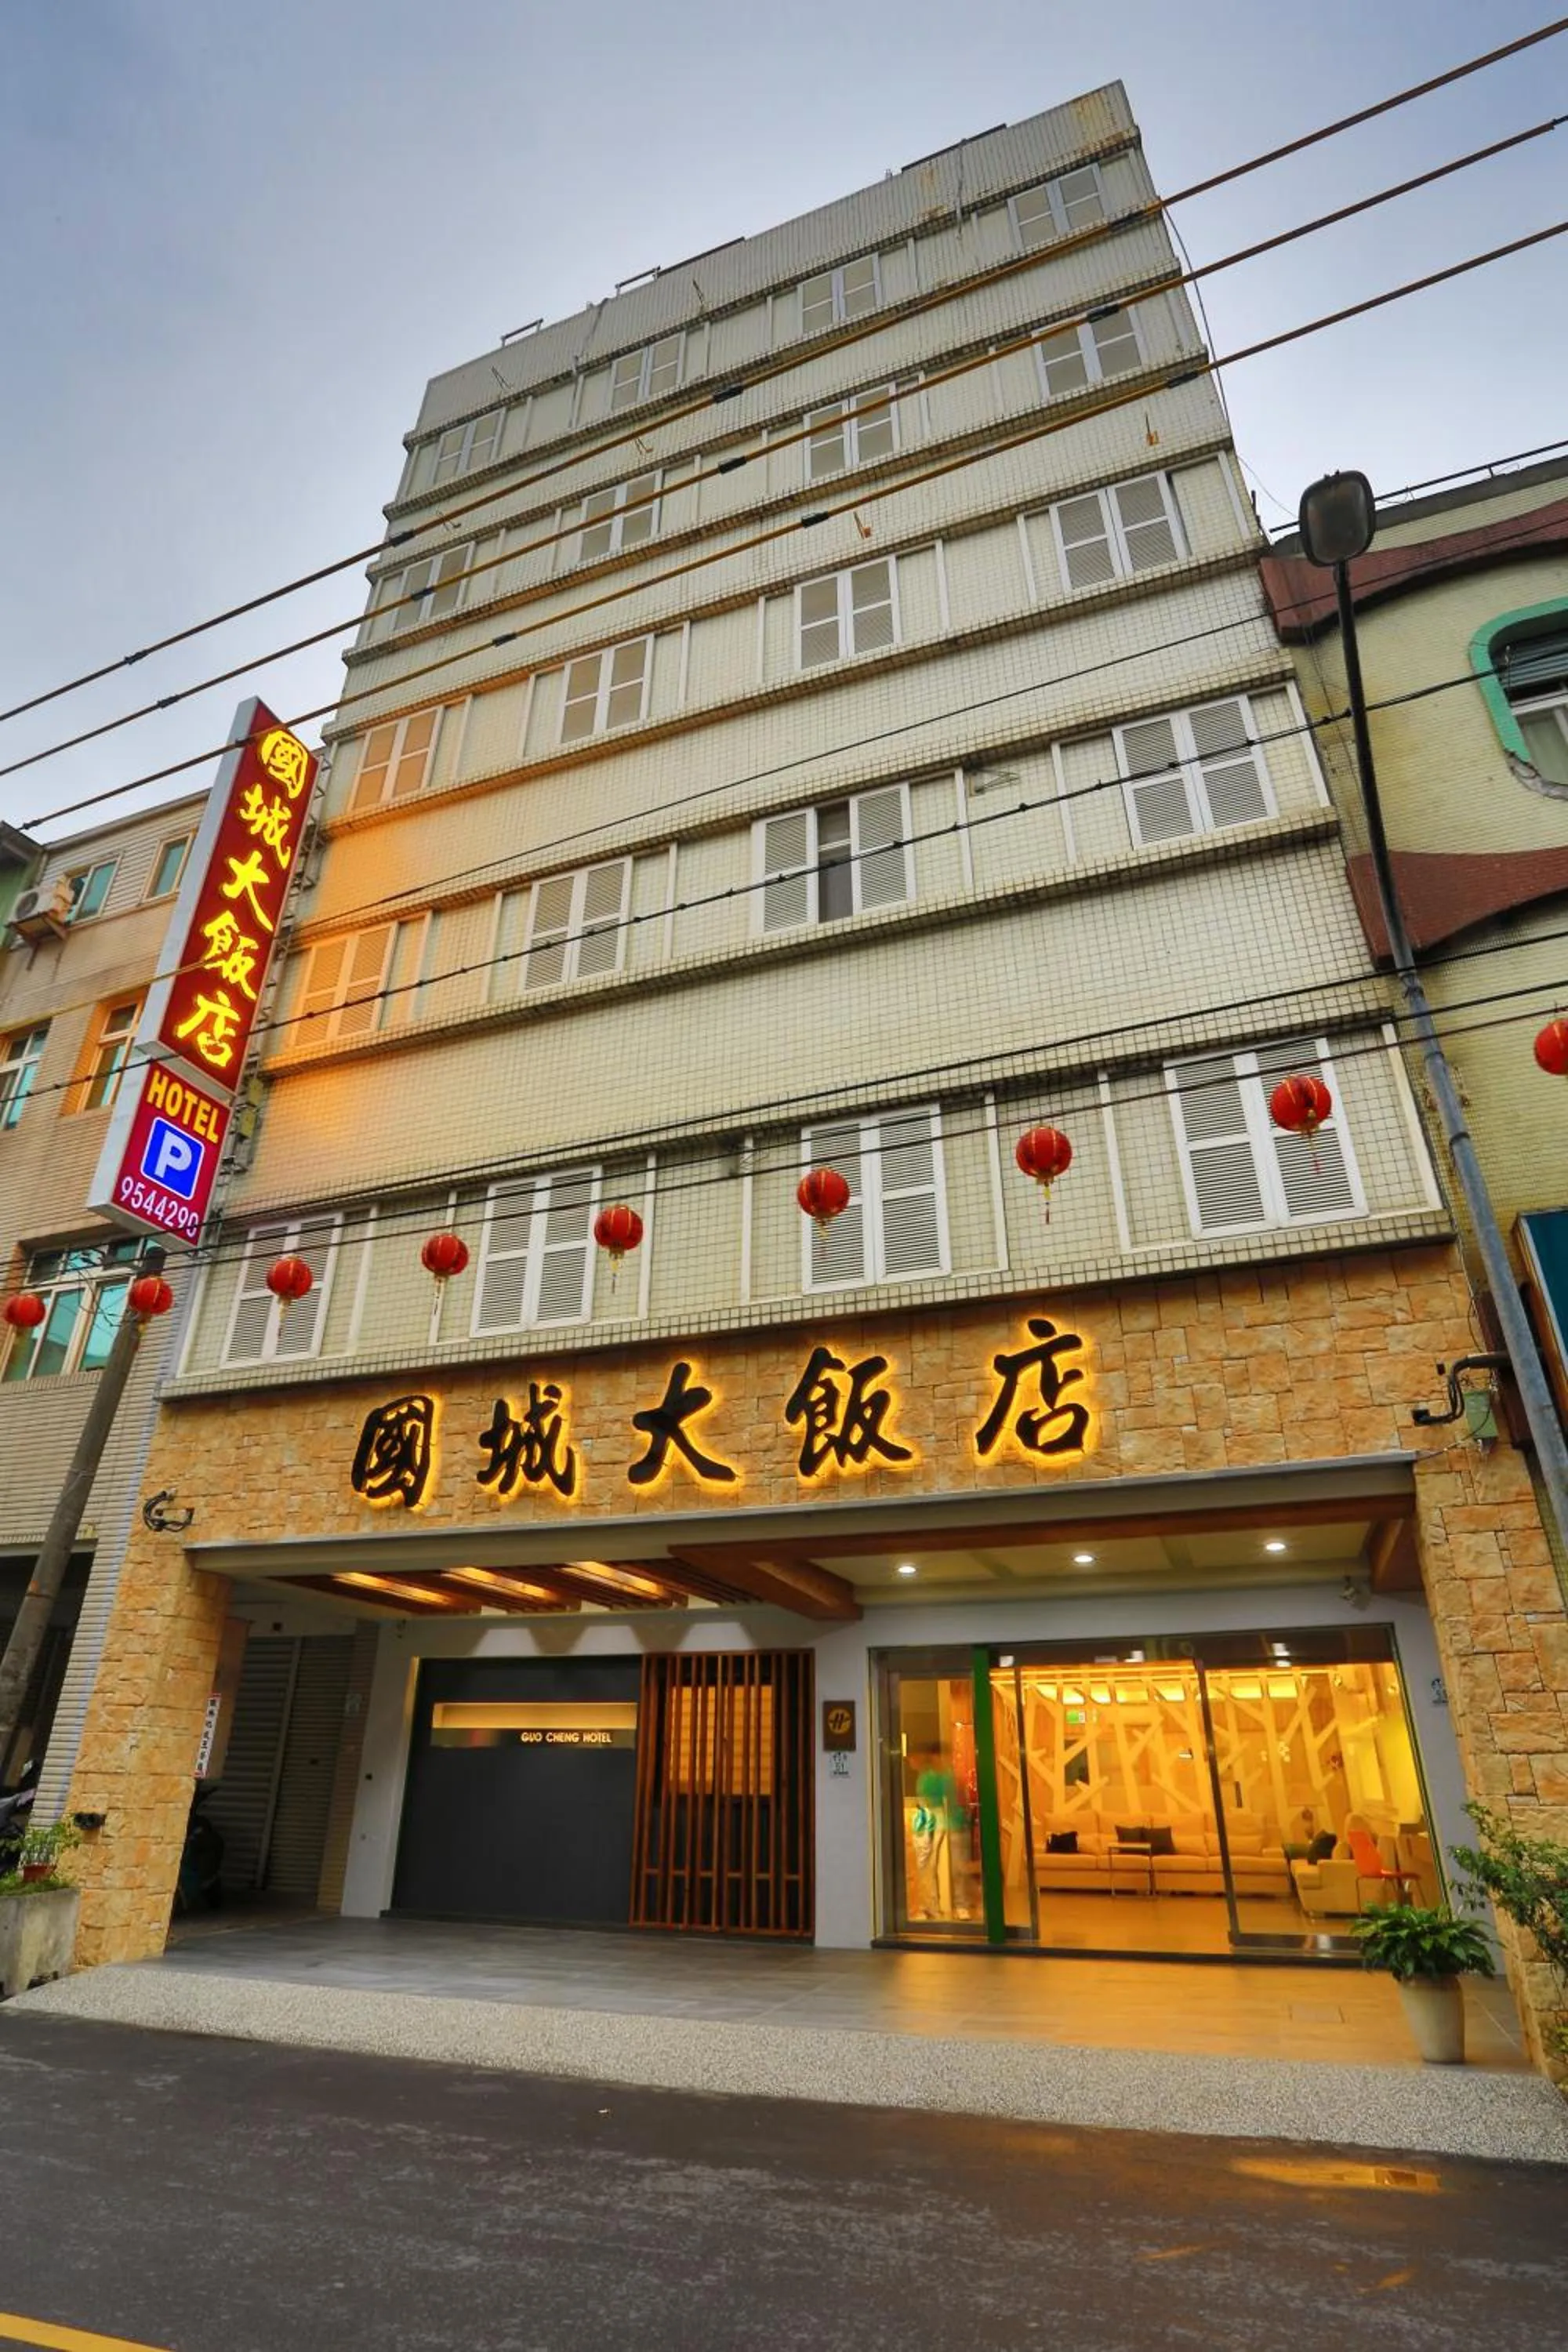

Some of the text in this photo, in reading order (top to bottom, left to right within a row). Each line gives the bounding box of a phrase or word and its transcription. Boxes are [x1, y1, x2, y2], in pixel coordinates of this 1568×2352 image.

[177, 729, 308, 1067] 國城大飯店
[147, 1070, 219, 1143] HOTEL
[154, 1130, 193, 1178] P
[120, 1176, 199, 1237] 9544290
[350, 1319, 1091, 1507] 國城大飯店
[521, 1731, 612, 1744] GUO CHENG HOTEL
